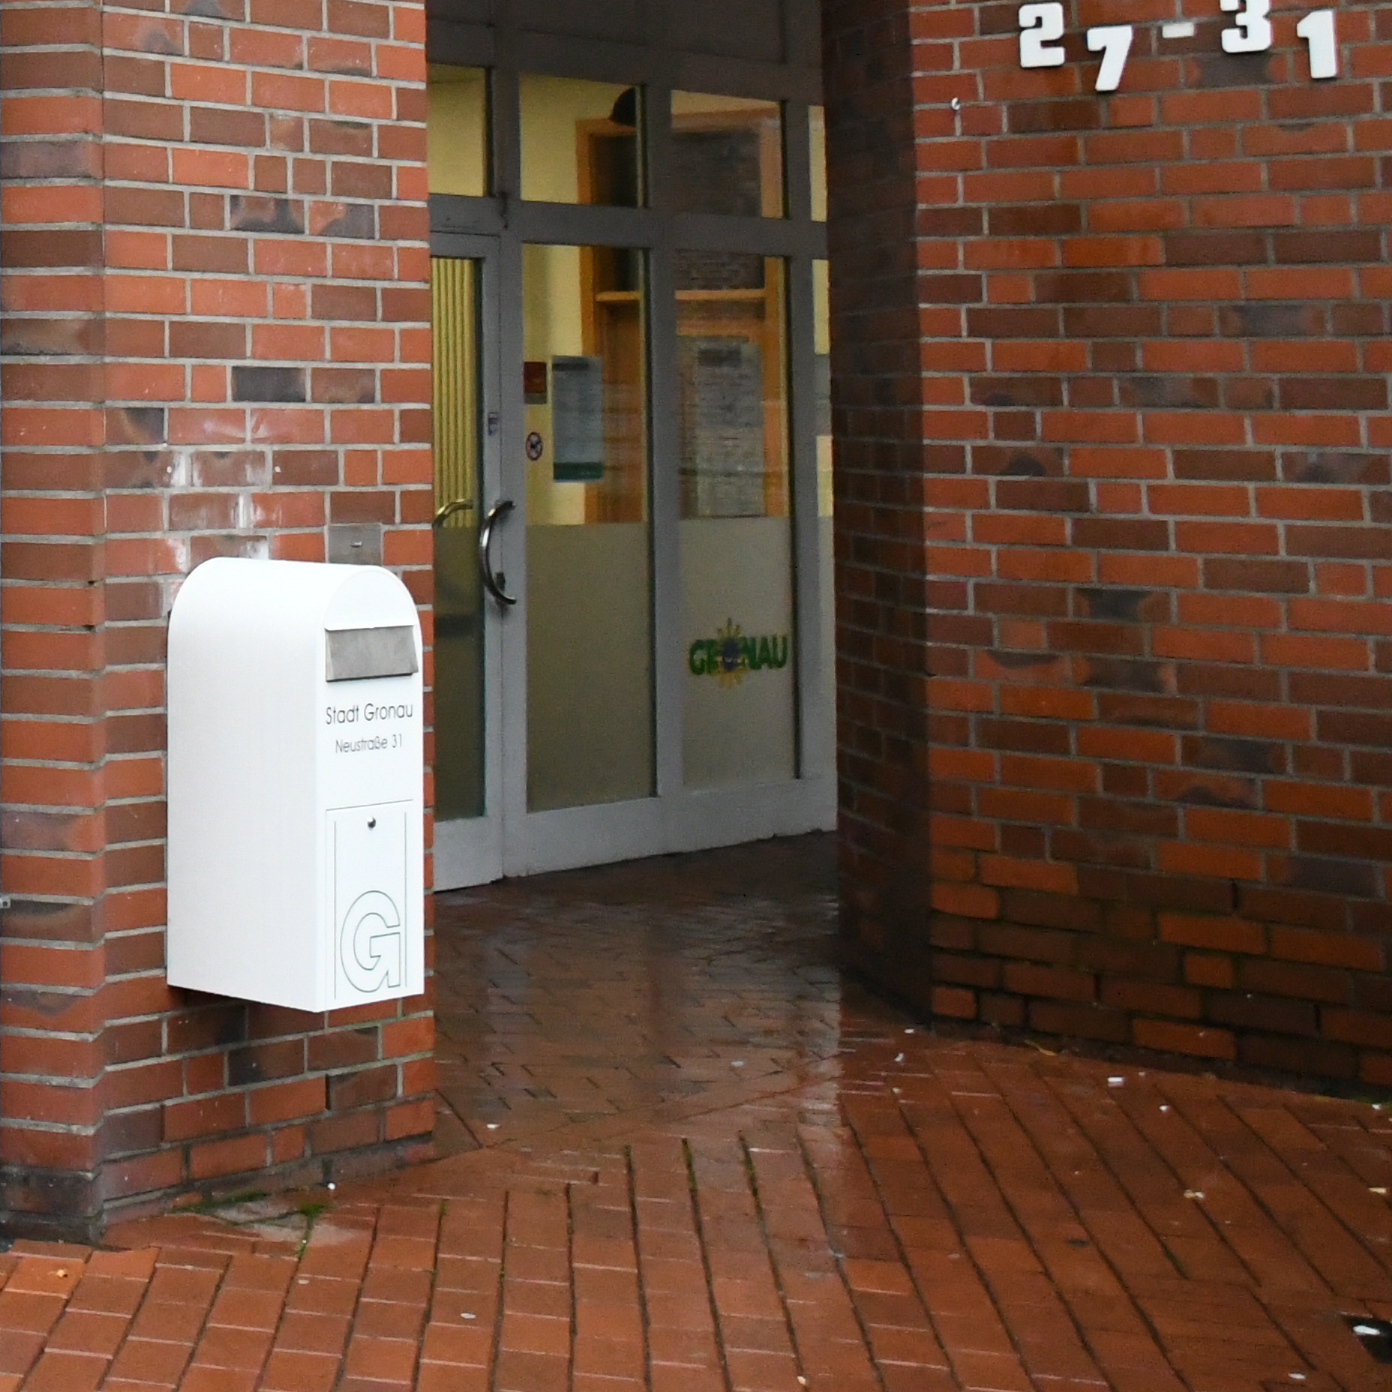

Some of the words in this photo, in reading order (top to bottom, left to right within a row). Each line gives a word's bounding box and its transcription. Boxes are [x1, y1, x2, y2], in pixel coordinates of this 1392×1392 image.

[325, 704, 360, 725] Stadt
[363, 701, 414, 721] Gronau
[335, 735, 389, 754] Neustraße
[391, 733, 404, 750] 31
